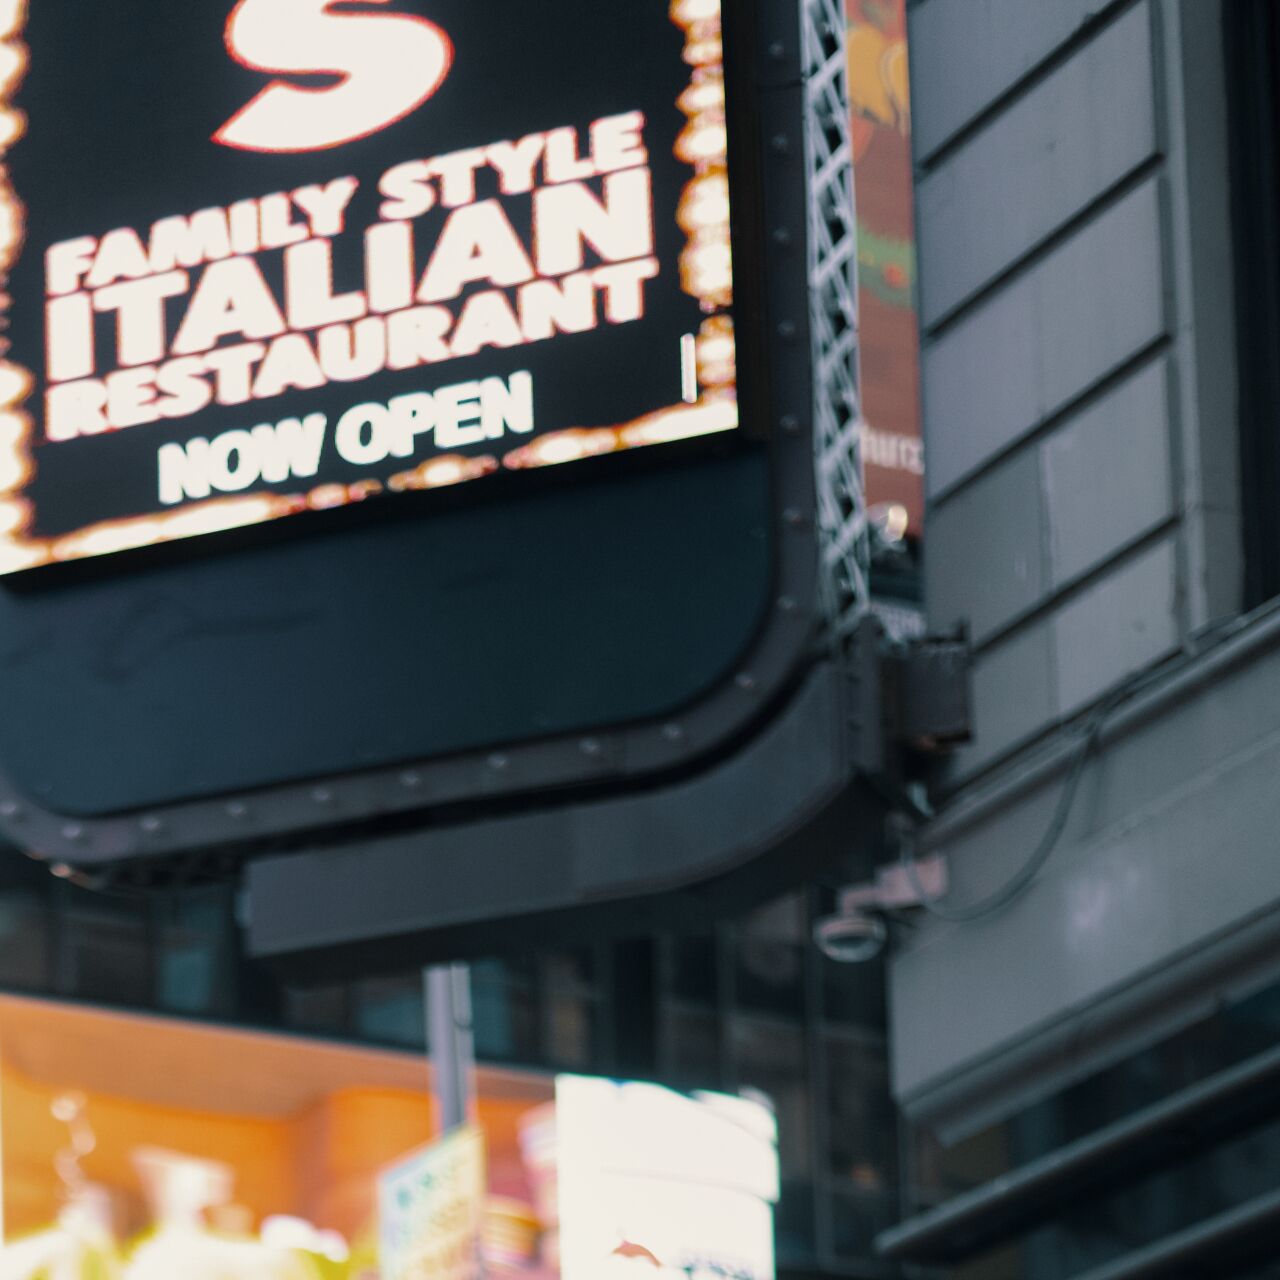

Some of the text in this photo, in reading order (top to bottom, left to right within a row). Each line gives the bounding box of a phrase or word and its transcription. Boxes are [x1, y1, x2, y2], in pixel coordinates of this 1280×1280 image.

[45, 109, 648, 297] FAMILY STYLE
[45, 165, 656, 383] ITALIAN
[45, 256, 660, 442] RESTAURANT
[157, 369, 534, 504] NOW OPEN
